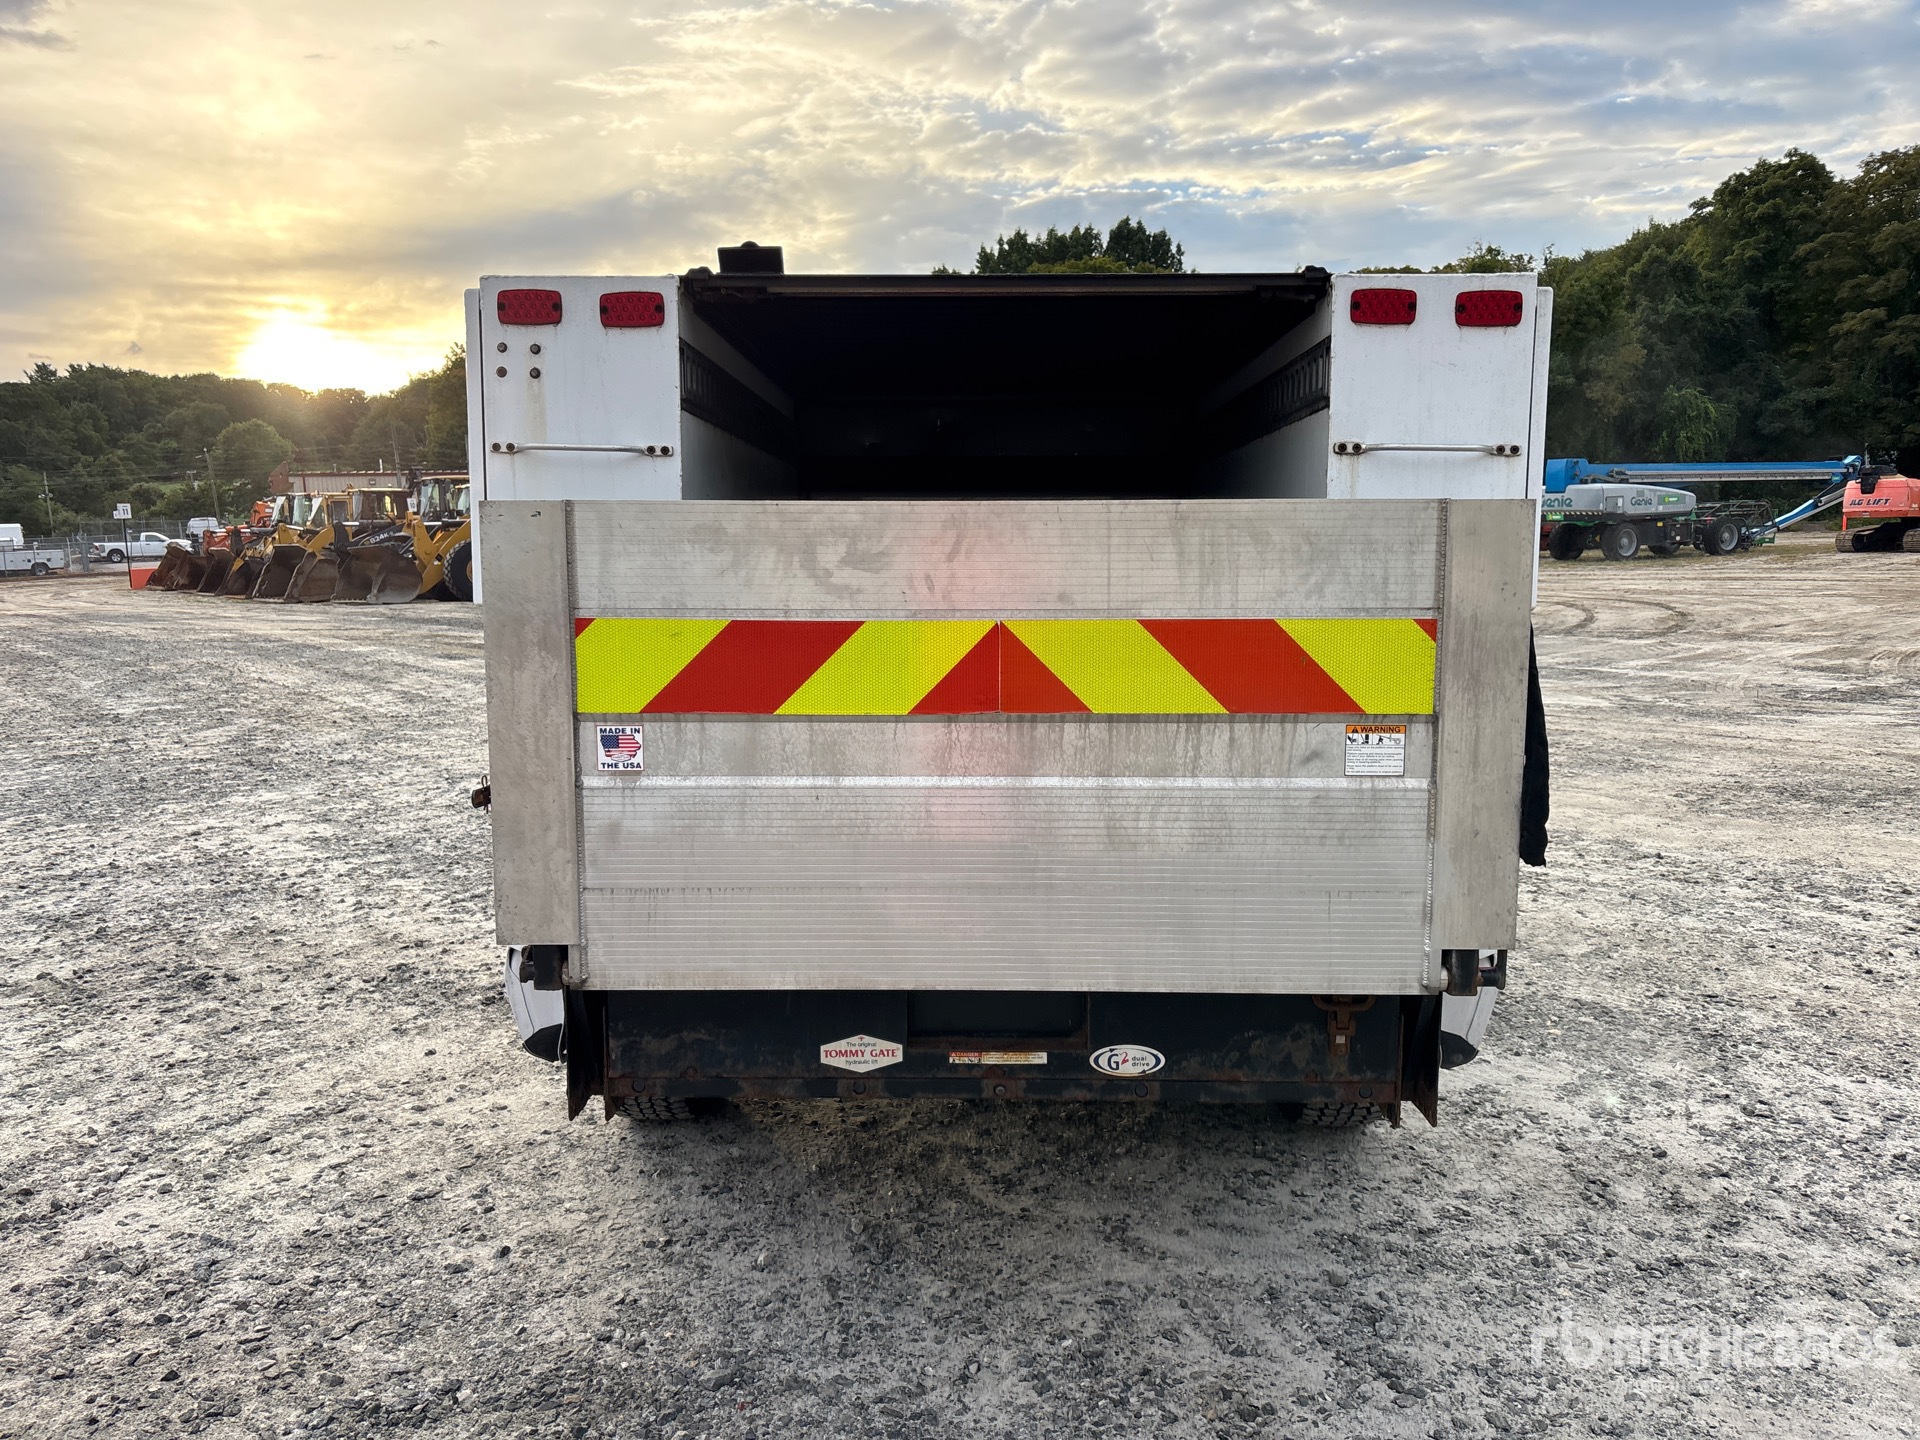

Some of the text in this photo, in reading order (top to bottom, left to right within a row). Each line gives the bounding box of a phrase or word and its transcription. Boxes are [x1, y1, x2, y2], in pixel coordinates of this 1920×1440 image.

[1630, 496, 1653, 507] Genie
[1849, 498, 1891, 506] JLG LIFT
[823, 1048, 897, 1058] TOMMY GATE
